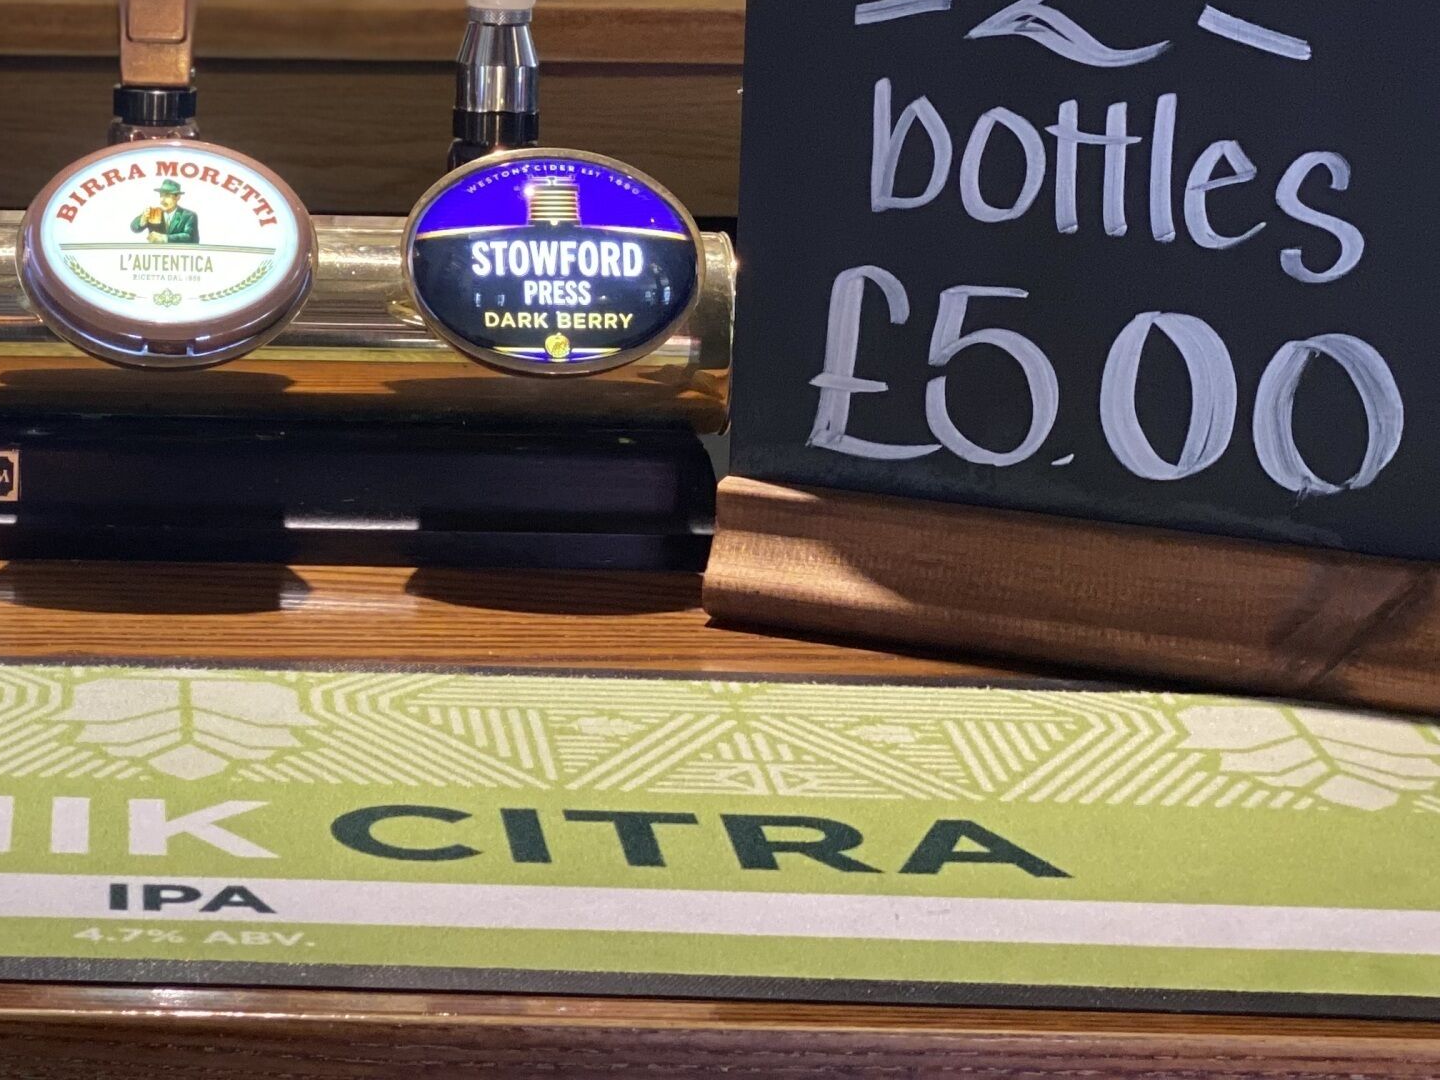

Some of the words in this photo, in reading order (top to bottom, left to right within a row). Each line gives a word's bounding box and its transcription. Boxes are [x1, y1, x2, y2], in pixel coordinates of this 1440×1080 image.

[56, 163, 147, 224] BIRRA
[156, 160, 278, 227] MORETTI
[869, 77, 1363, 284] bottles
[119, 254, 214, 273] L'AUTENTICA
[471, 240, 645, 277] STOWFORD
[523, 281, 592, 306] PRESS
[484, 312, 549, 329] DARK
[556, 311, 634, 329] BERRY
[806, 265, 1405, 495] £5.00
[330, 804, 1076, 879] CITRA
[109, 883, 278, 914] IPA
[73, 927, 186, 944] 4.7%
